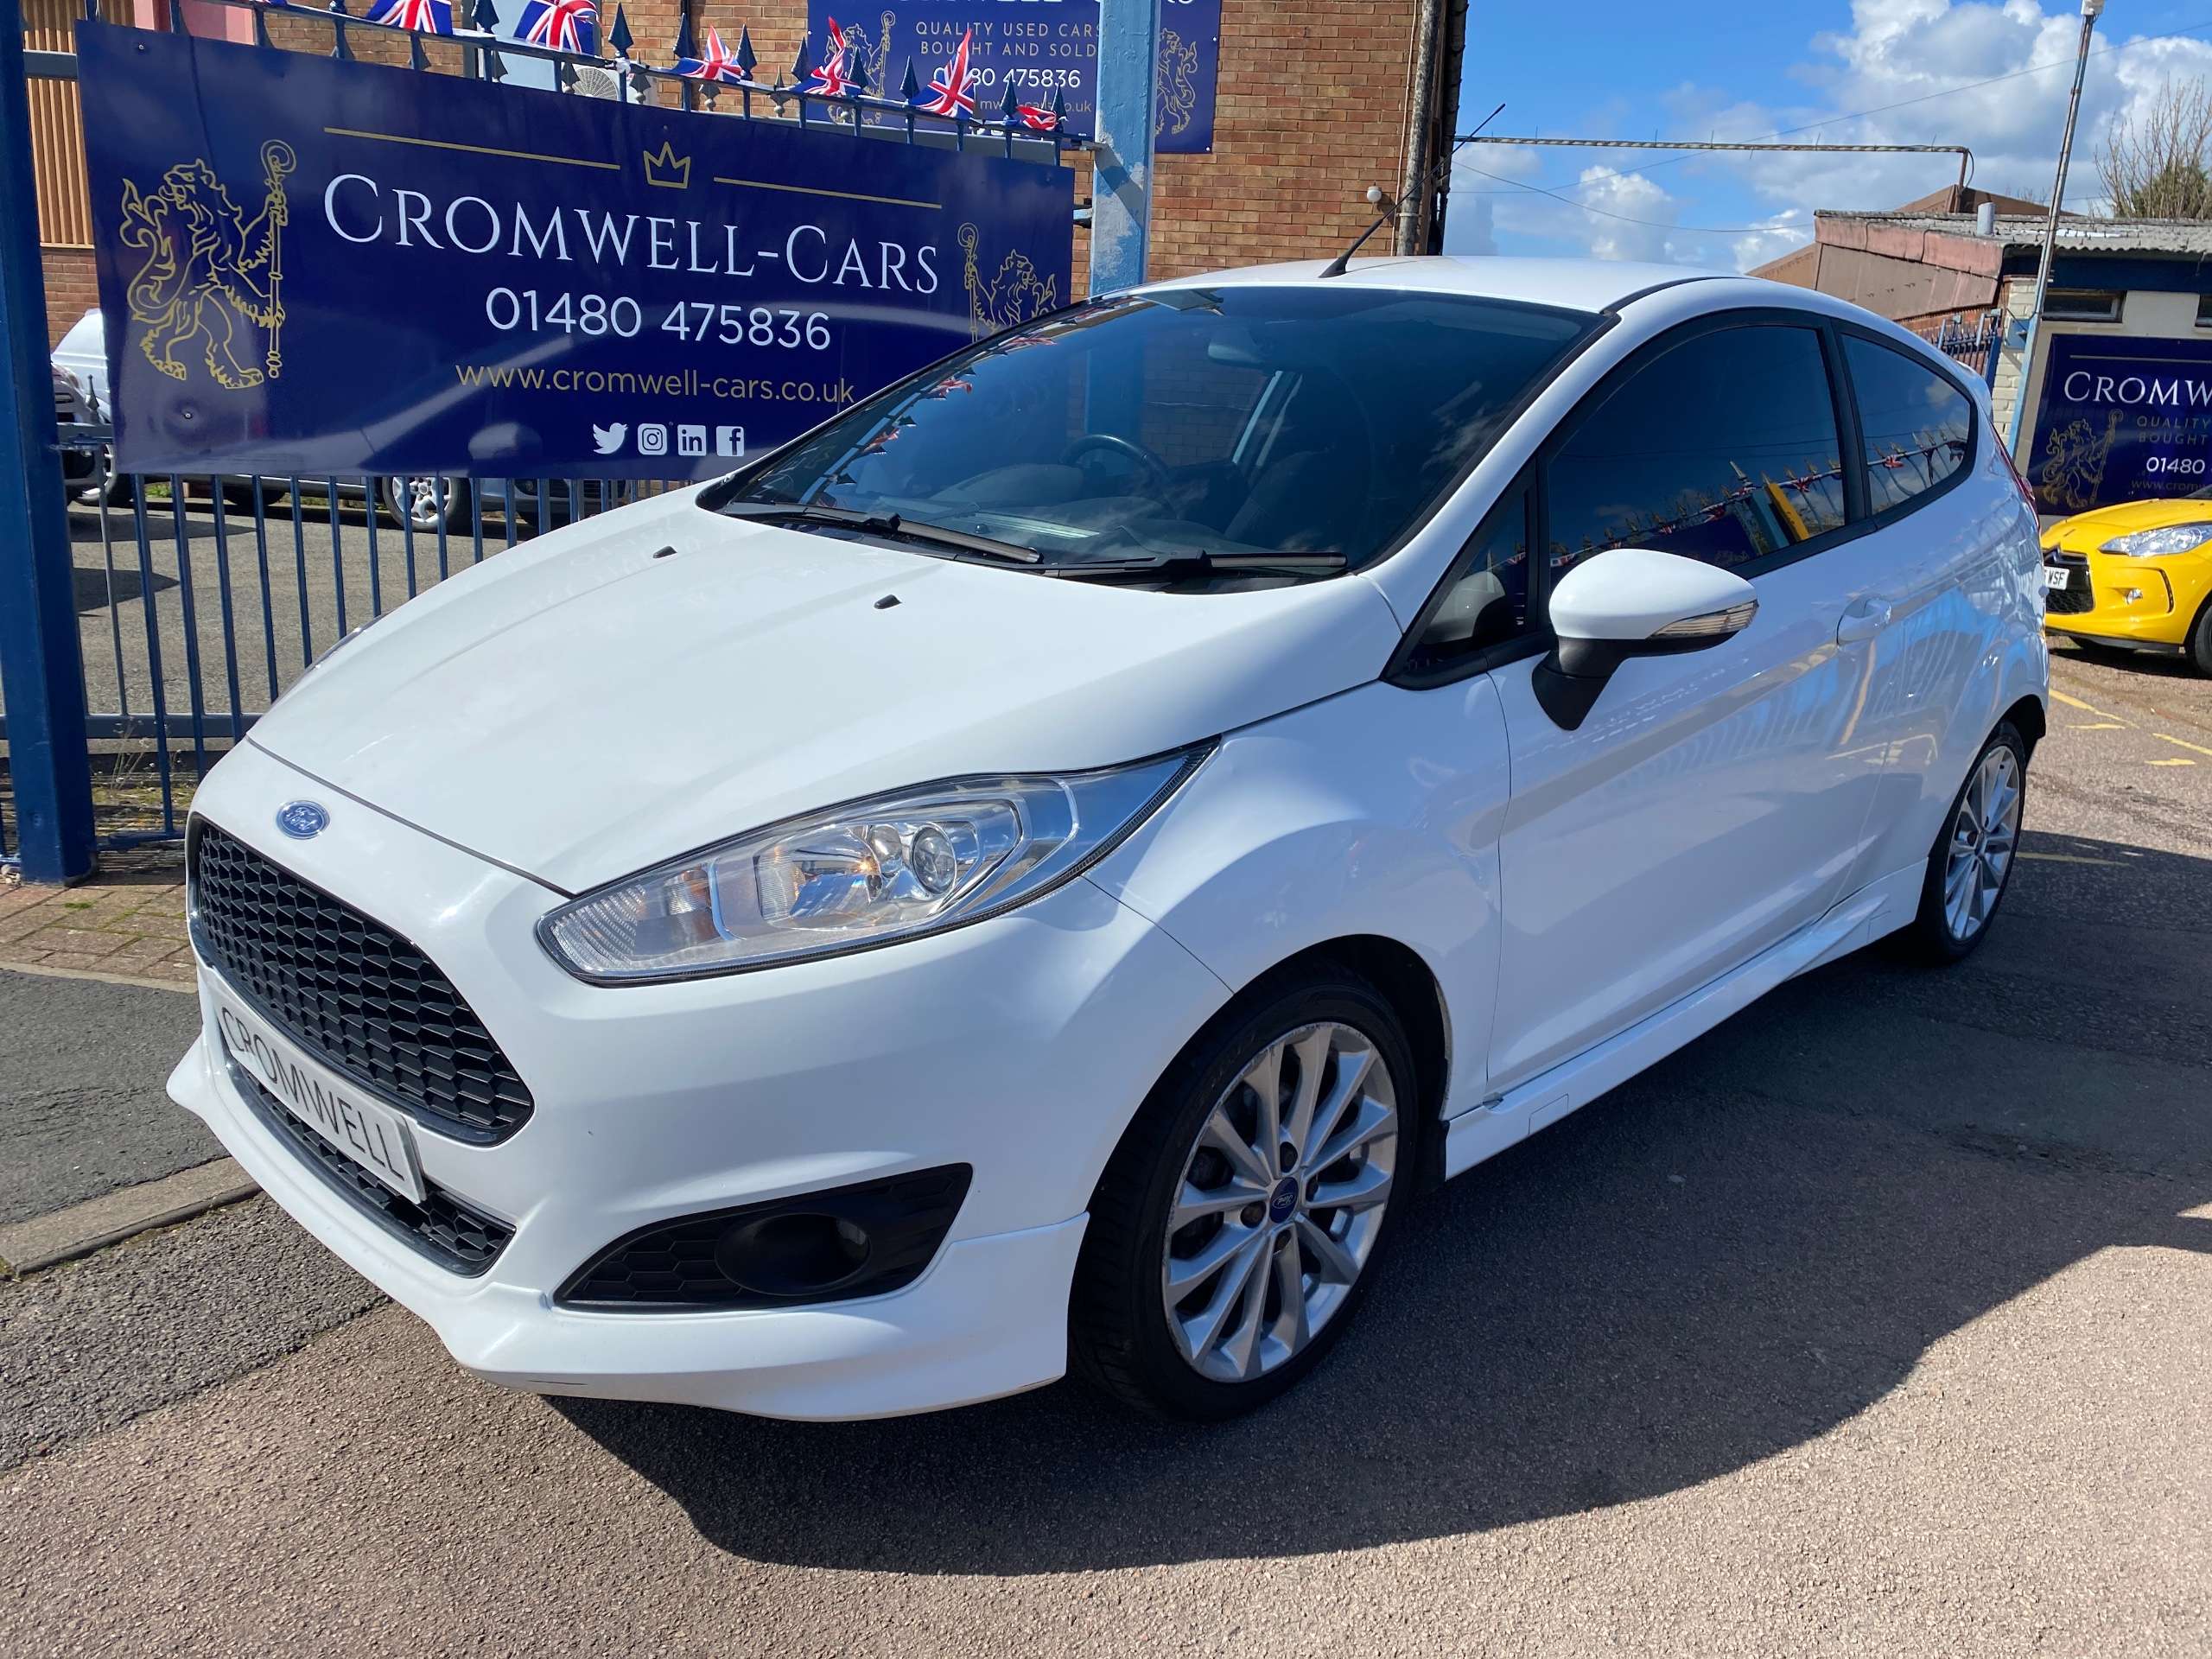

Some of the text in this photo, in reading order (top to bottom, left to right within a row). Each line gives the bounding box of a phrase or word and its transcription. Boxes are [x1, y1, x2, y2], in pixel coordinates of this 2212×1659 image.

[916, 22, 994, 36] QUALITY
[1003, 22, 1049, 36] USED
[920, 41, 1096, 57] BOUHT AND SOLD
[1002, 69, 1081, 88] 475836
[323, 173, 939, 295] CROMWELL-CARS
[486, 287, 831, 350] 01480 475836
[454, 364, 855, 404] www.cromwell-cars.co.uk
[2136, 415, 2211, 430] QUALITY
[2138, 433, 2209, 447] BOUGHT
[2145, 456, 2206, 474] 01480
[221, 1006, 406, 1183] CROMWELL
